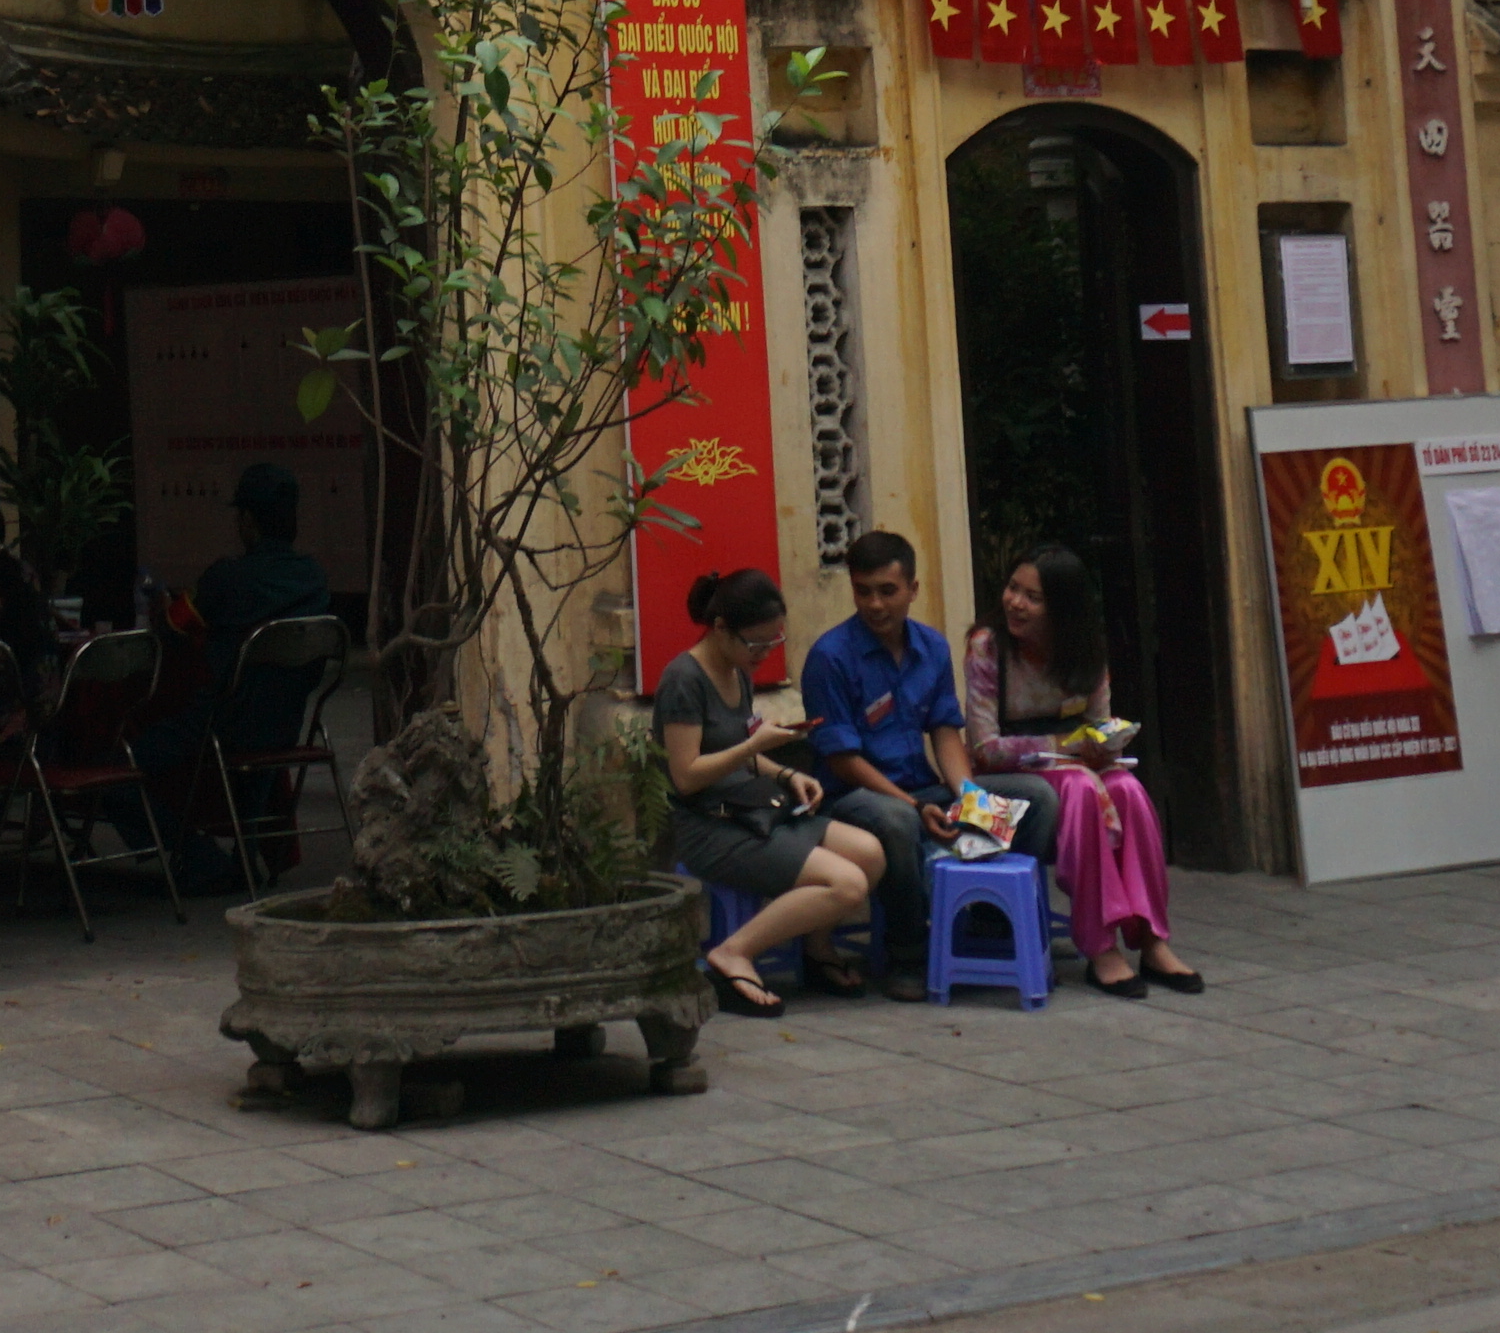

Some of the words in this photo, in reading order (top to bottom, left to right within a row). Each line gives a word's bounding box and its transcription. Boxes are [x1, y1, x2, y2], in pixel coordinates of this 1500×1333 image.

[617, 22, 641, 59] ĐẠI
[643, 12, 675, 53] BIỂU
[677, 14, 713, 56] QUỐC
[716, 19, 739, 60] HỘI
[642, 63, 661, 98] VÀ
[663, 69, 687, 105] ĐẠI
[1303, 525, 1395, 596] XIV
